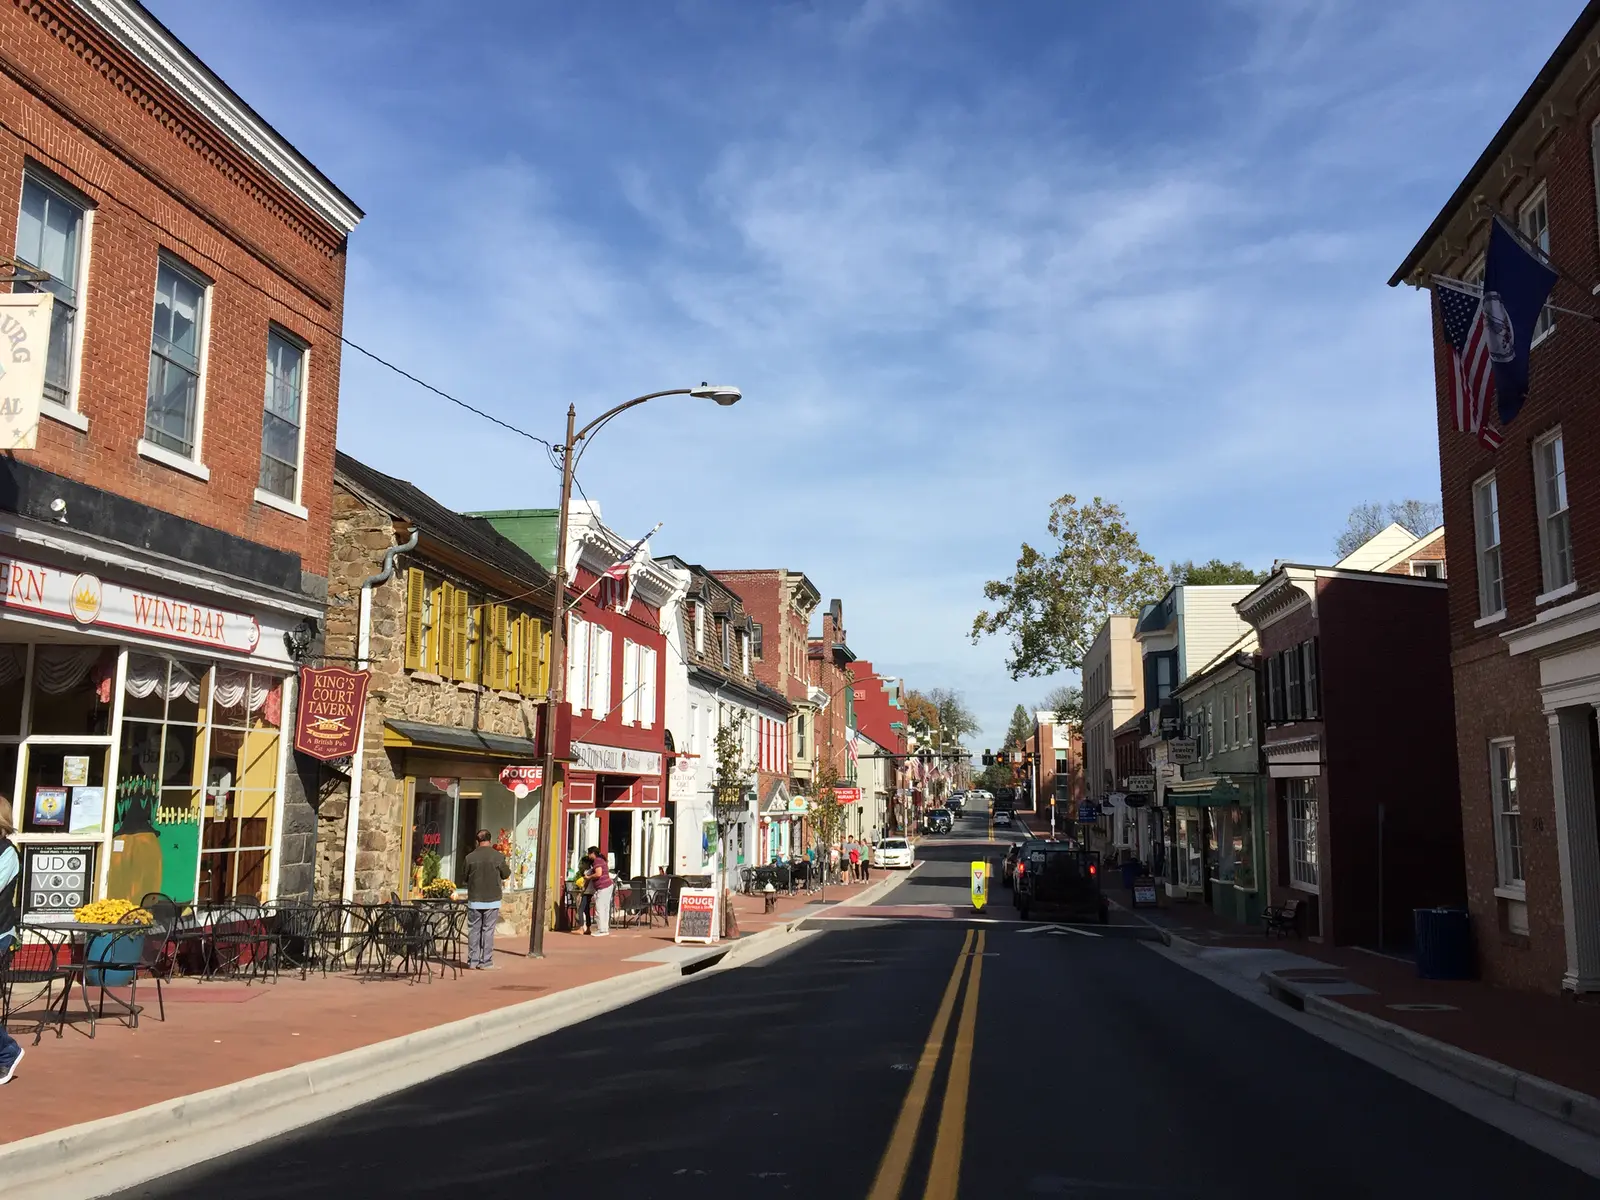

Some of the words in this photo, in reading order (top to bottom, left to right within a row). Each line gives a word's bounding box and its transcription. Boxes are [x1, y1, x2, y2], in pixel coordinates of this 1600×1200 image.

[0, 313, 31, 363] URG
[133, 594, 187, 633] WINE
[191, 607, 226, 644] BAR
[314, 674, 356, 691] KING'S
[312, 688, 355, 704] COURT
[308, 701, 355, 717] TAVERN
[314, 738, 333, 746] British
[335, 739, 347, 748] Pub
[502, 769, 542, 779] ROUGE
[37, 856, 82, 871] UDO
[35, 874, 80, 889] VOO
[34, 892, 81, 908] DOO
[682, 897, 714, 905] ROUGE
